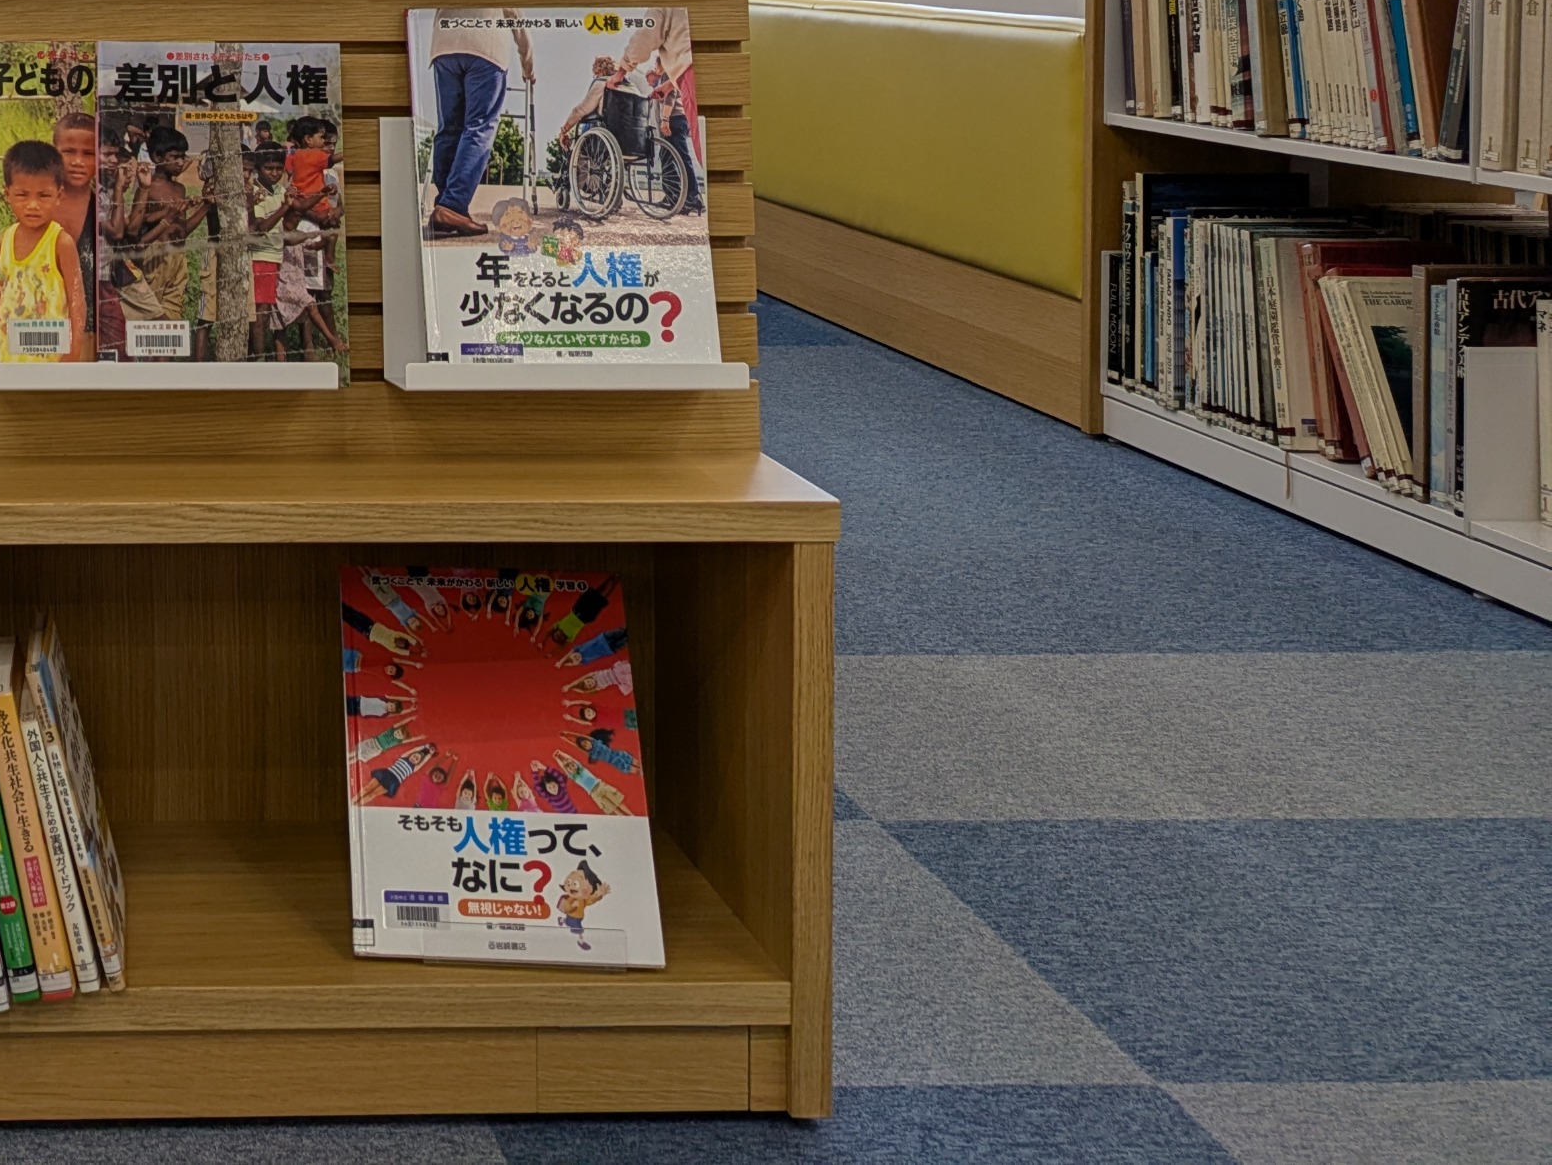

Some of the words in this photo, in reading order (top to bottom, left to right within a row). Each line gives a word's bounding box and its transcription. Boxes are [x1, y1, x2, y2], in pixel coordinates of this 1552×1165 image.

[440, 17, 493, 30] 気づくことで
[495, 17, 552, 29] 未来がかわる
[555, 18, 583, 29] 新しい
[586, 13, 621, 32] 人権
[624, 17, 644, 29] 学習
[175, 51, 262, 63] 差別される子どもたち
[113, 62, 329, 106] 差別と人権
[475, 252, 659, 289] 年をとると人権が
[459, 289, 683, 343] 少なくなるの?
[1362, 297, 1382, 306] THE
[1383, 297, 1413, 307] GARDE
[1109, 312, 1117, 354] MOON
[1266, 276, 1283, 371] 日本庭園鑑賞事典
[372, 576, 425, 589] 気づくことで
[427, 577, 483, 589] 未来がかわる
[486, 577, 514, 589] 新しい
[518, 576, 551, 593] 人権
[555, 580, 576, 591] 学習
[45, 731, 55, 743] 3
[50, 751, 86, 862] 自然と環境をまもるきまり
[26, 728, 76, 913] 外国人と共生するための実践ガイドブック
[451, 856, 553, 906] なに?
[467, 901, 541, 917] 無視じゃない!
